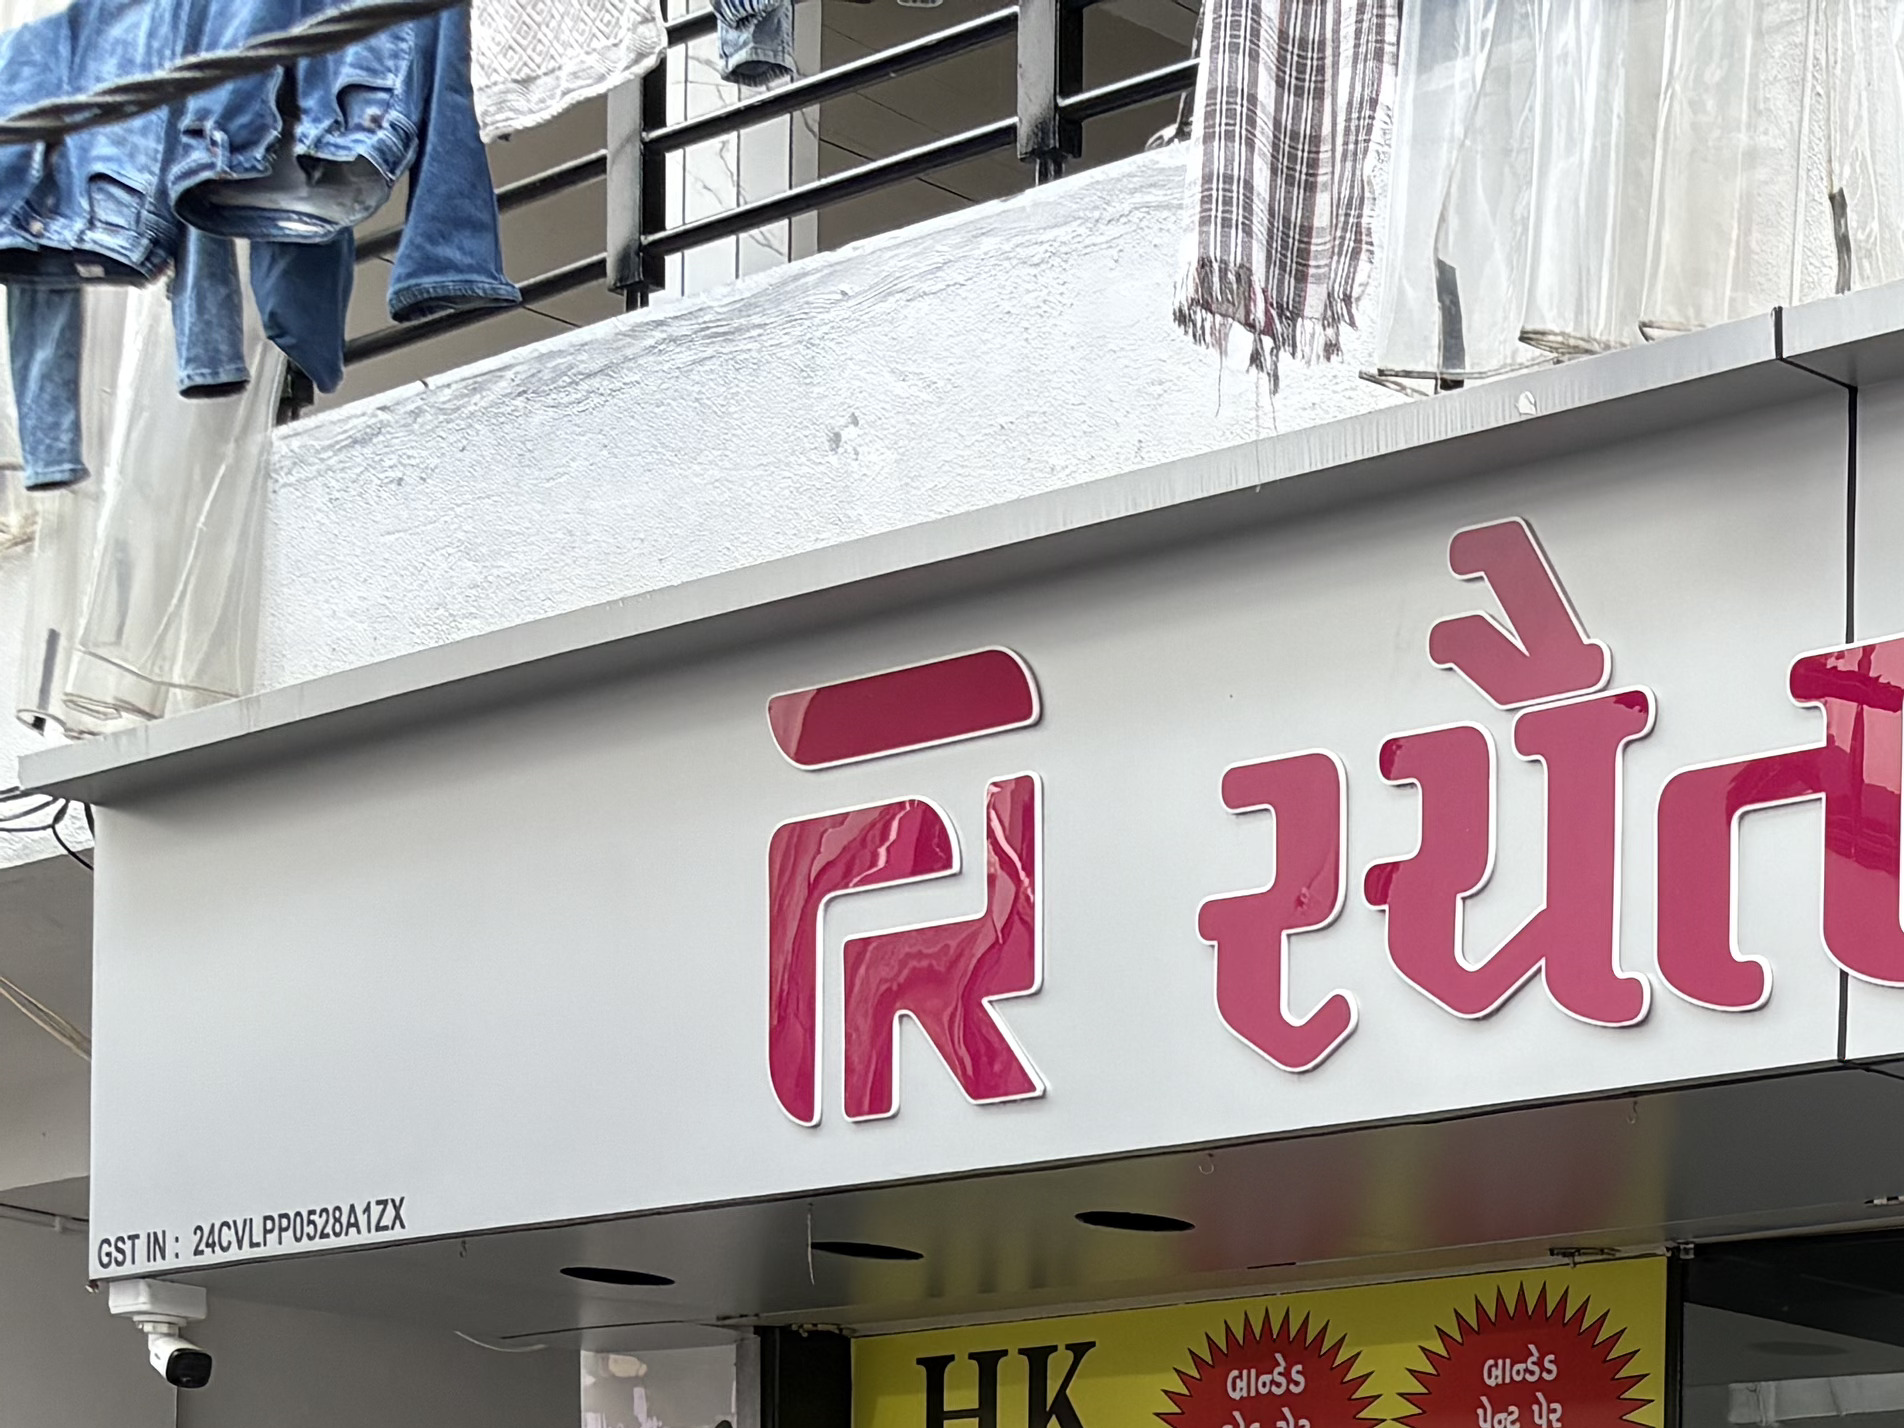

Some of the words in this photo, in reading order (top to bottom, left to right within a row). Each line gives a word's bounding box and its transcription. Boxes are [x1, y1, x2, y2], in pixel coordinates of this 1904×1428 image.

[97, 1233, 140, 1269] GST
[146, 1229, 166, 1262] IN
[193, 1196, 406, 1257] 24CVLPP0528A1ZX
